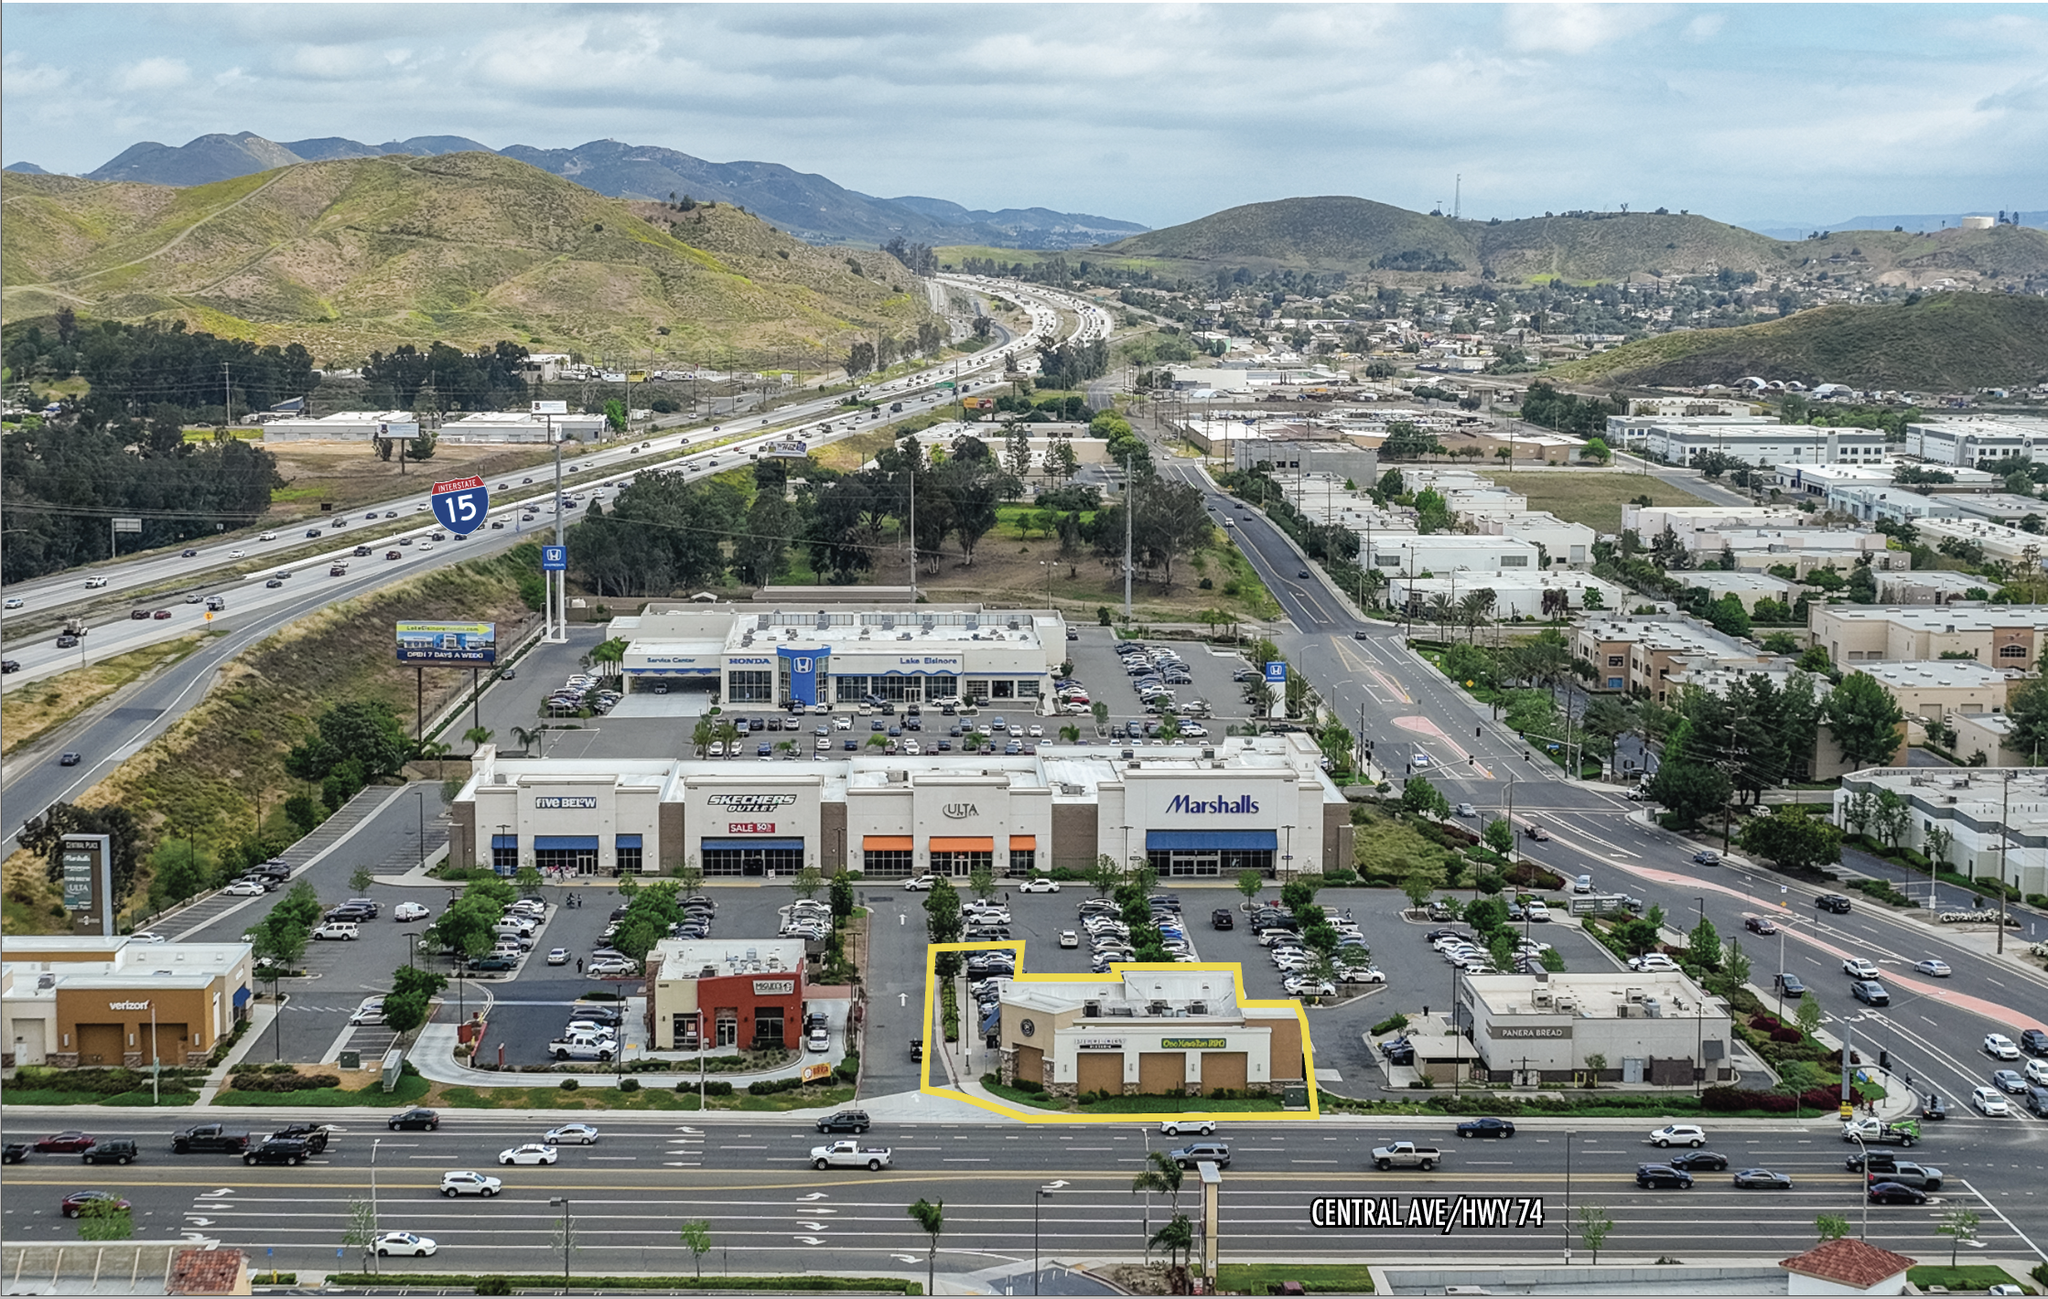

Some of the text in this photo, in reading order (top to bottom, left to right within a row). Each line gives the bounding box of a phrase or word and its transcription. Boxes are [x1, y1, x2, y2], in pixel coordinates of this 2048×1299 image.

[536, 798, 596, 808] five BELOW
[707, 794, 797, 805] SKECHERS
[1165, 794, 1260, 814] Marshalls
[727, 804, 778, 812] OUTLET
[947, 803, 979, 817] ULTA
[730, 824, 754, 832] SALE
[69, 884, 88, 892] ULTA
[109, 1000, 149, 1010] verizon
[1502, 1029, 1563, 1037] PANERA BREAD
